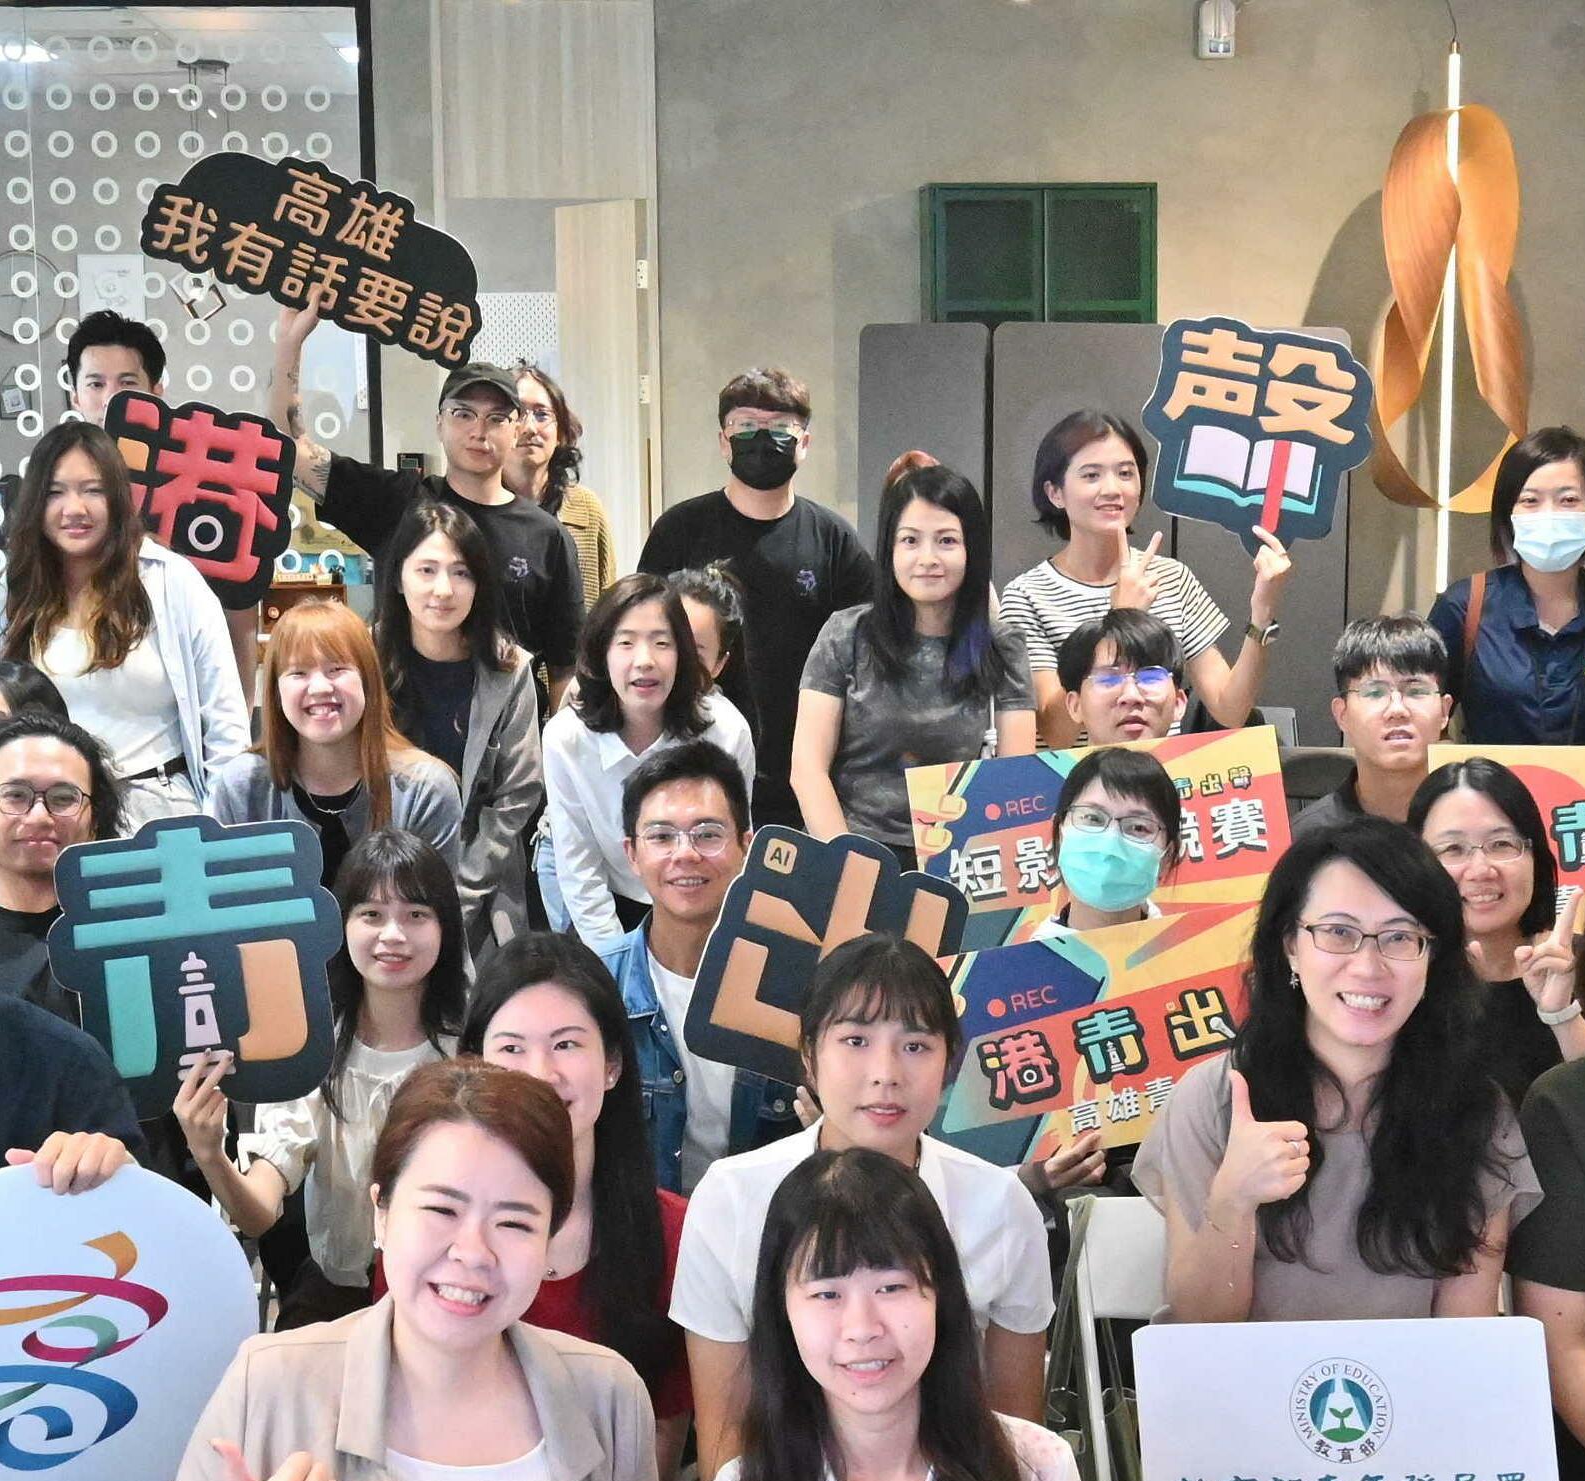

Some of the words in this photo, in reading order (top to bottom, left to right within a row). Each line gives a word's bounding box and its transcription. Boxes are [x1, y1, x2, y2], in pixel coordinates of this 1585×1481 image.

[273, 167, 405, 261] 高雄
[152, 195, 472, 361] 我有話要說
[117, 398, 282, 583] 港
[1004, 796, 1047, 818] REC
[769, 841, 792, 867] AI
[74, 827, 316, 1079] 青
[1010, 985, 1058, 1012] REC
[1295, 1371, 1319, 1440] MINISTRY
[1320, 1364, 1339, 1377] OF
[1344, 1364, 1387, 1439] EDUCATION
[1313, 1438, 1376, 1463] 教育部
